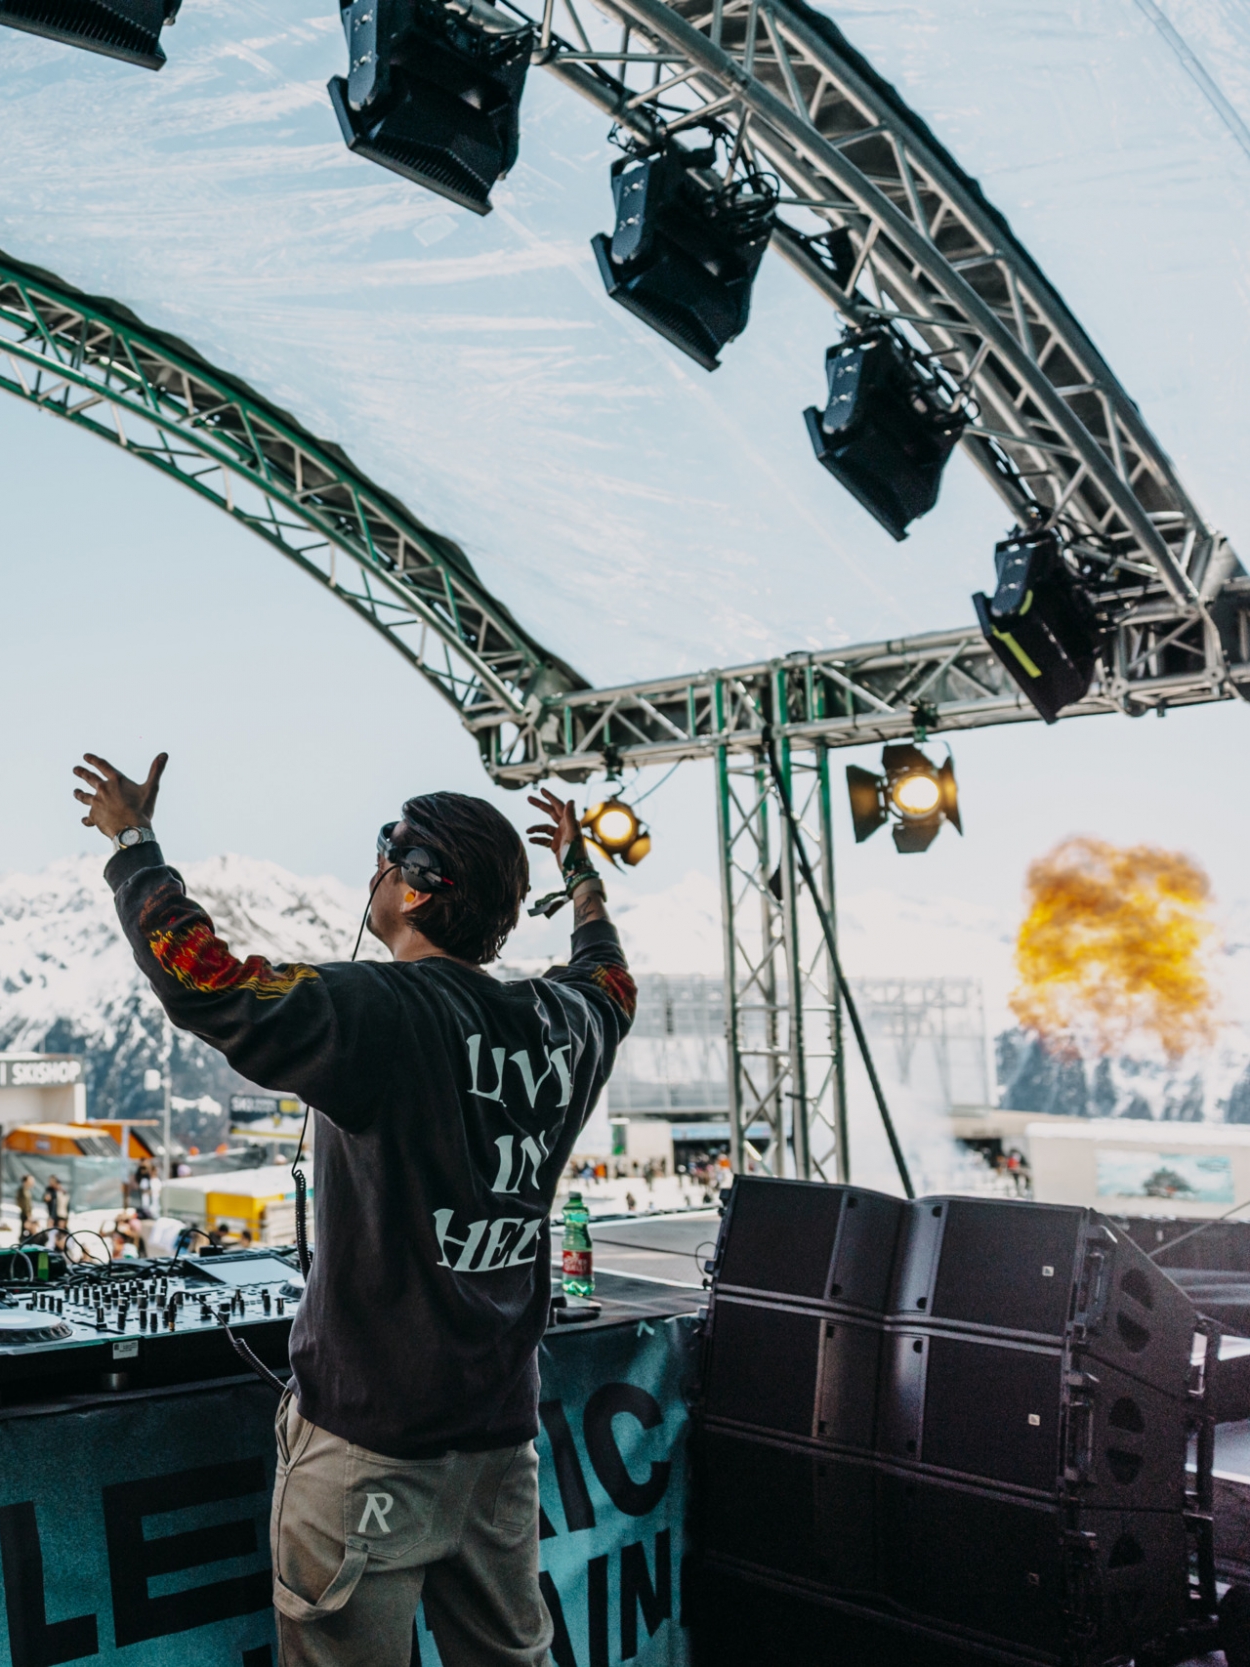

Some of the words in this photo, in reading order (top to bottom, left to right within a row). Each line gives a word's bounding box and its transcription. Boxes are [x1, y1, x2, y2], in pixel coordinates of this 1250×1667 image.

[12, 1061, 81, 1084] SKISHOP
[491, 1130, 549, 1194] IN
[433, 1208, 541, 1272] HEL
